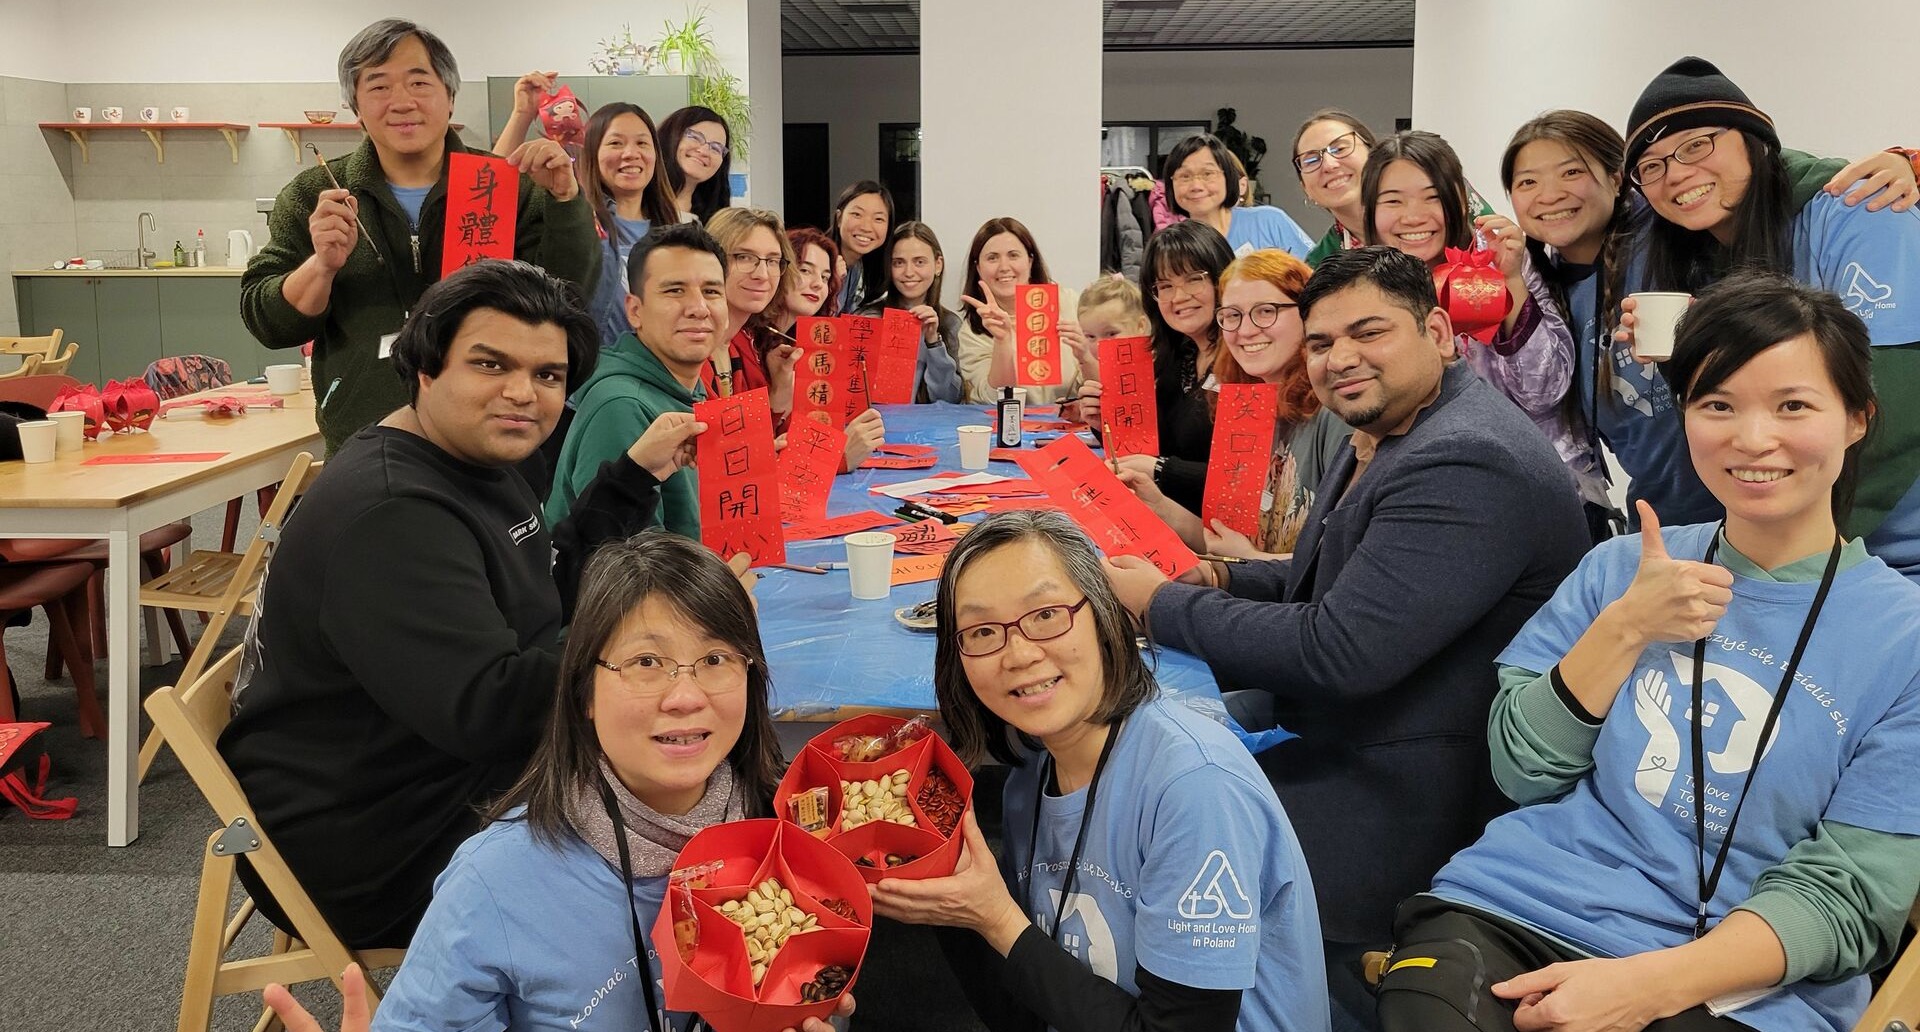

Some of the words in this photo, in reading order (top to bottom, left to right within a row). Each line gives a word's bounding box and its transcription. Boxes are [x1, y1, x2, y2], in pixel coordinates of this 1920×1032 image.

[458, 162, 499, 266] 身體
[1029, 291, 1050, 378] 日日開心
[808, 324, 833, 422] 龍馬精
[1114, 343, 1151, 455] 日日開心
[719, 404, 769, 563] 日日開心
[1749, 647, 1775, 666] się,
[1829, 710, 1849, 736] się
[1672, 803, 1690, 818] To
[1679, 788, 1696, 803] To
[1704, 801, 1728, 818] are
[1704, 782, 1731, 801] love
[1167, 919, 1191, 934] Light
[1193, 922, 1211, 934] and
[1212, 923, 1236, 934] Love
[1192, 936, 1201, 947] in
[1203, 937, 1236, 948] Poland
[570, 967, 627, 1030] Kochać,
